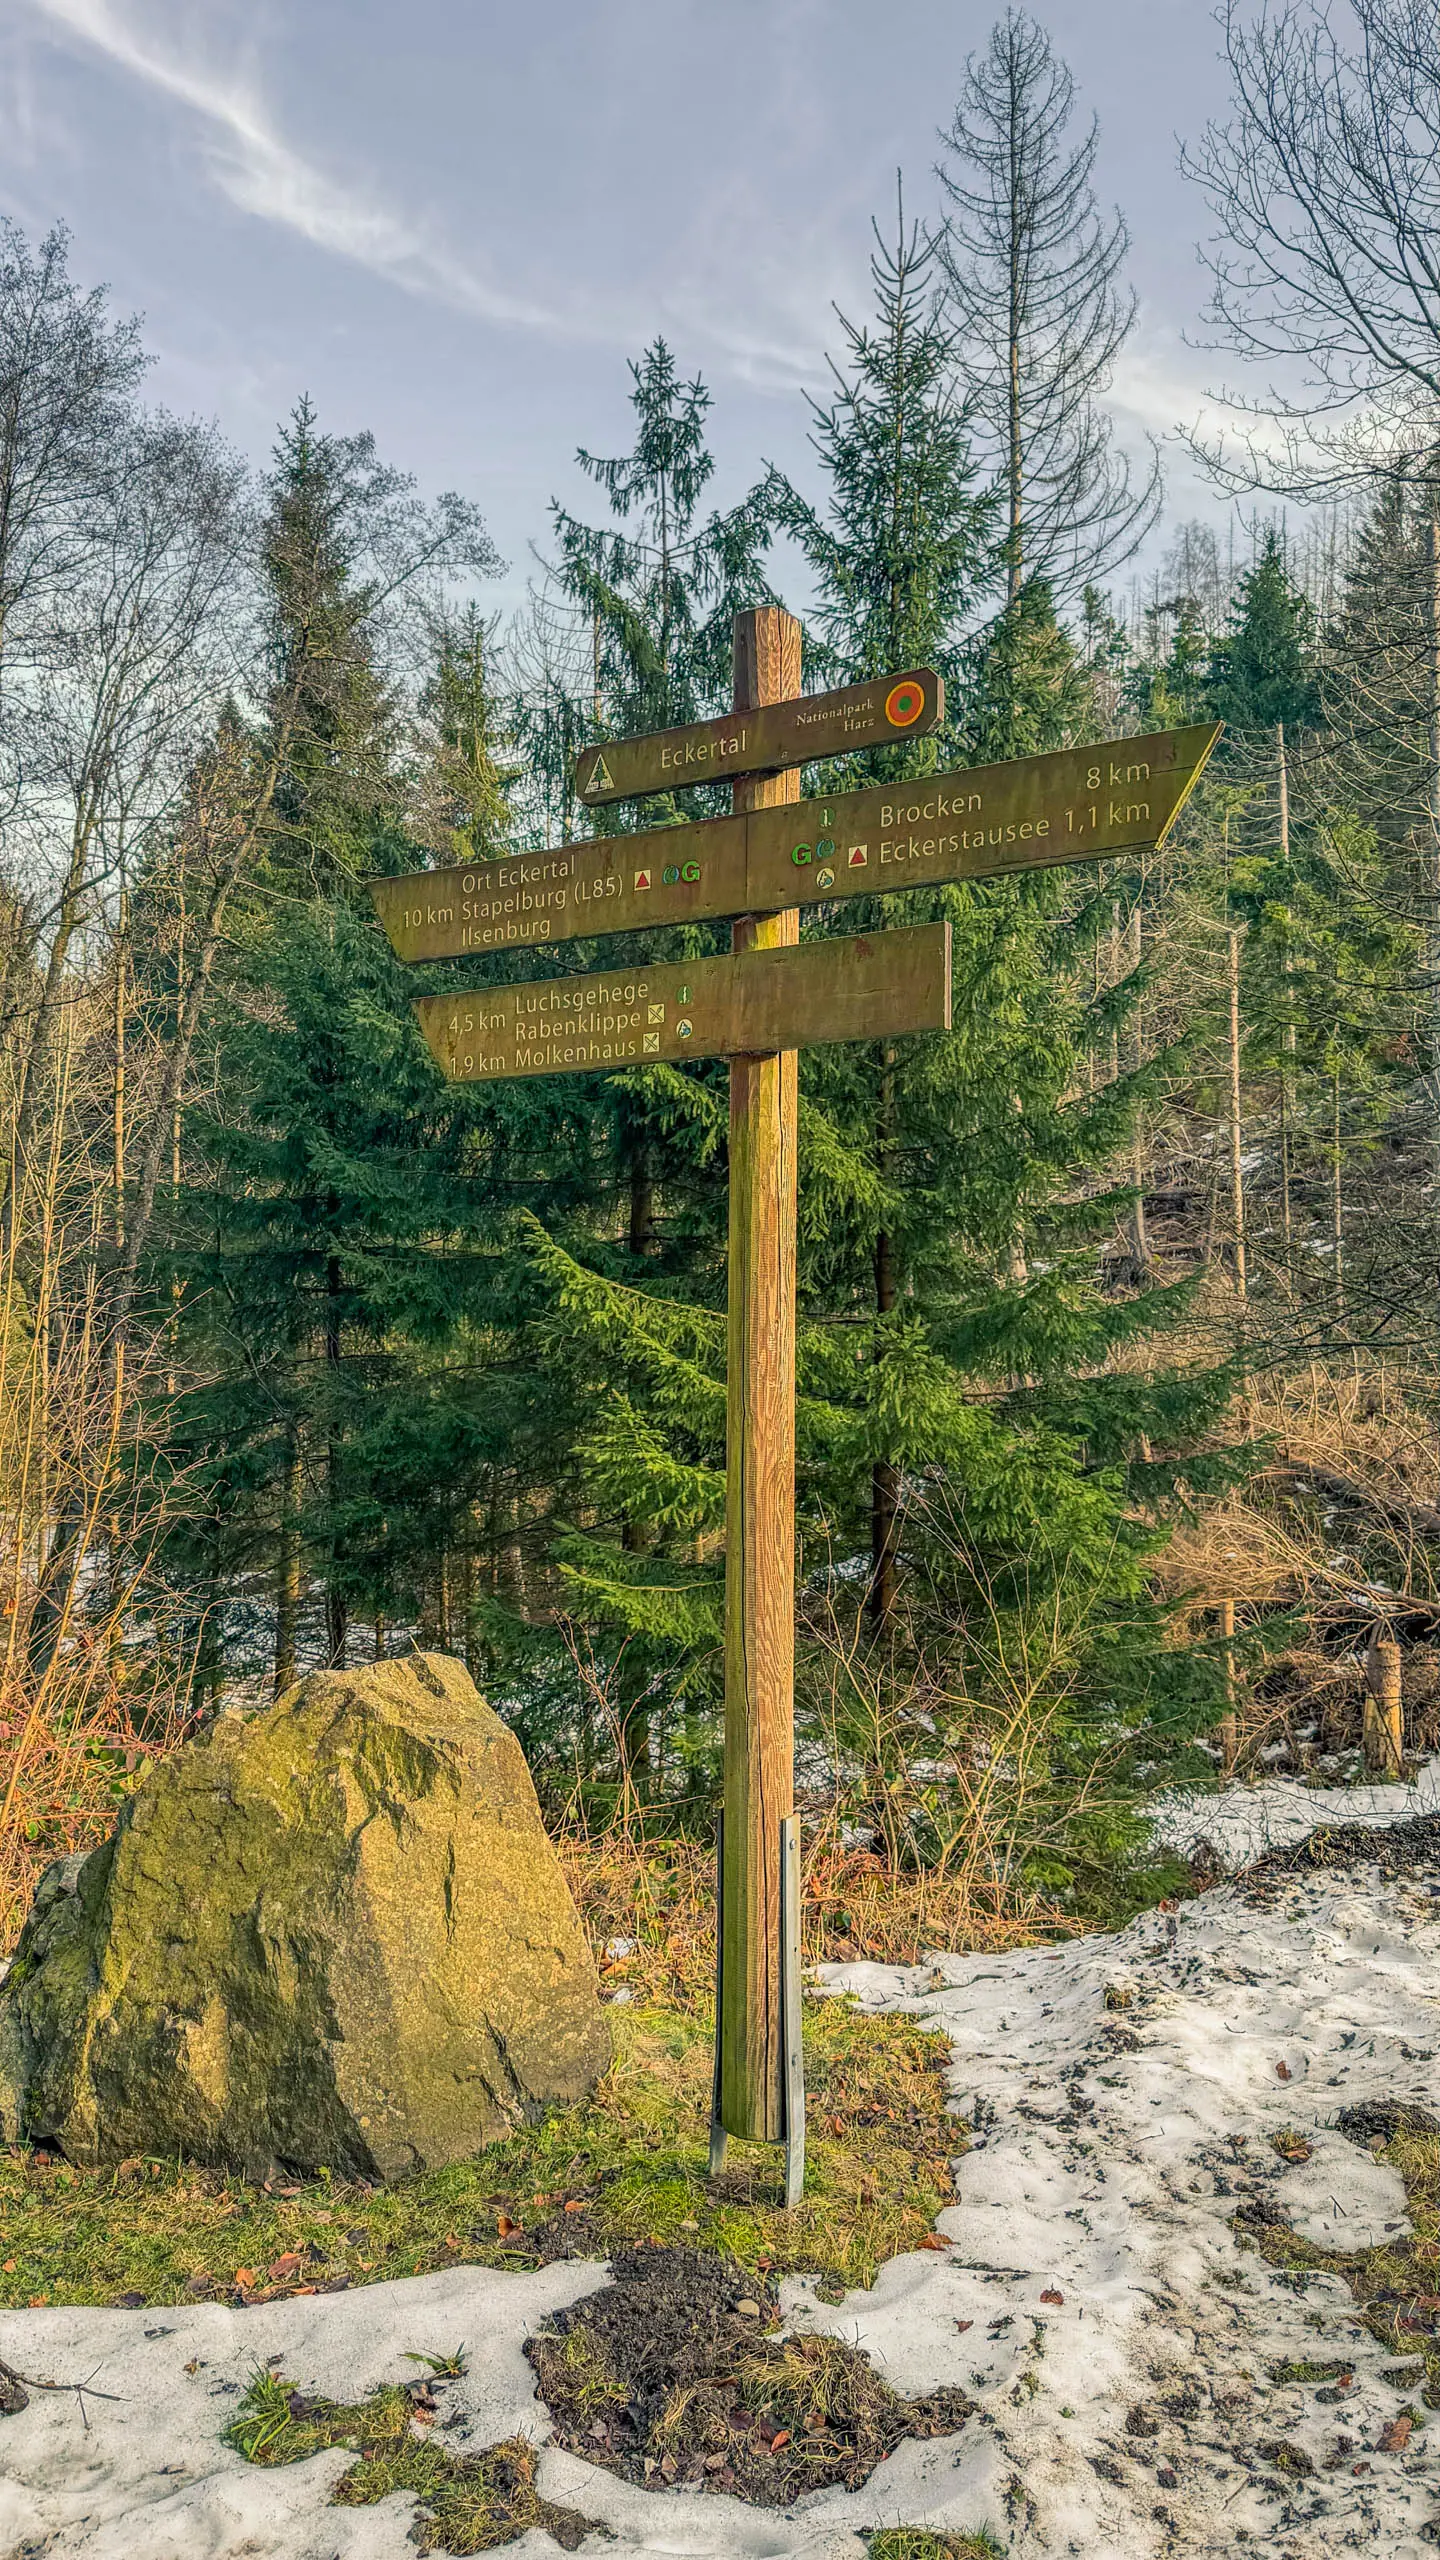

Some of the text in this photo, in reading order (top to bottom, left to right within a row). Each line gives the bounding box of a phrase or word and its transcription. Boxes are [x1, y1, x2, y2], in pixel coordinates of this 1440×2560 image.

[796, 698, 874, 726] Nationalpark
[843, 718, 874, 733] Harz
[661, 729, 746, 769] Eckertal
[880, 760, 1151, 827] Brocken 8 km
[879, 801, 1151, 863] Eckerstausee 1,1 km
[462, 855, 575, 894] Ort Eckertal
[403, 878, 624, 928] 10 km Stapelburg (L85)
[461, 918, 551, 947] Ilsenburg
[515, 982, 648, 1014] Luchsgehege
[449, 1011, 641, 1041] 4,5 km Rabenklippe
[449, 1042, 636, 1077] 1,9 km Molkenhaus
